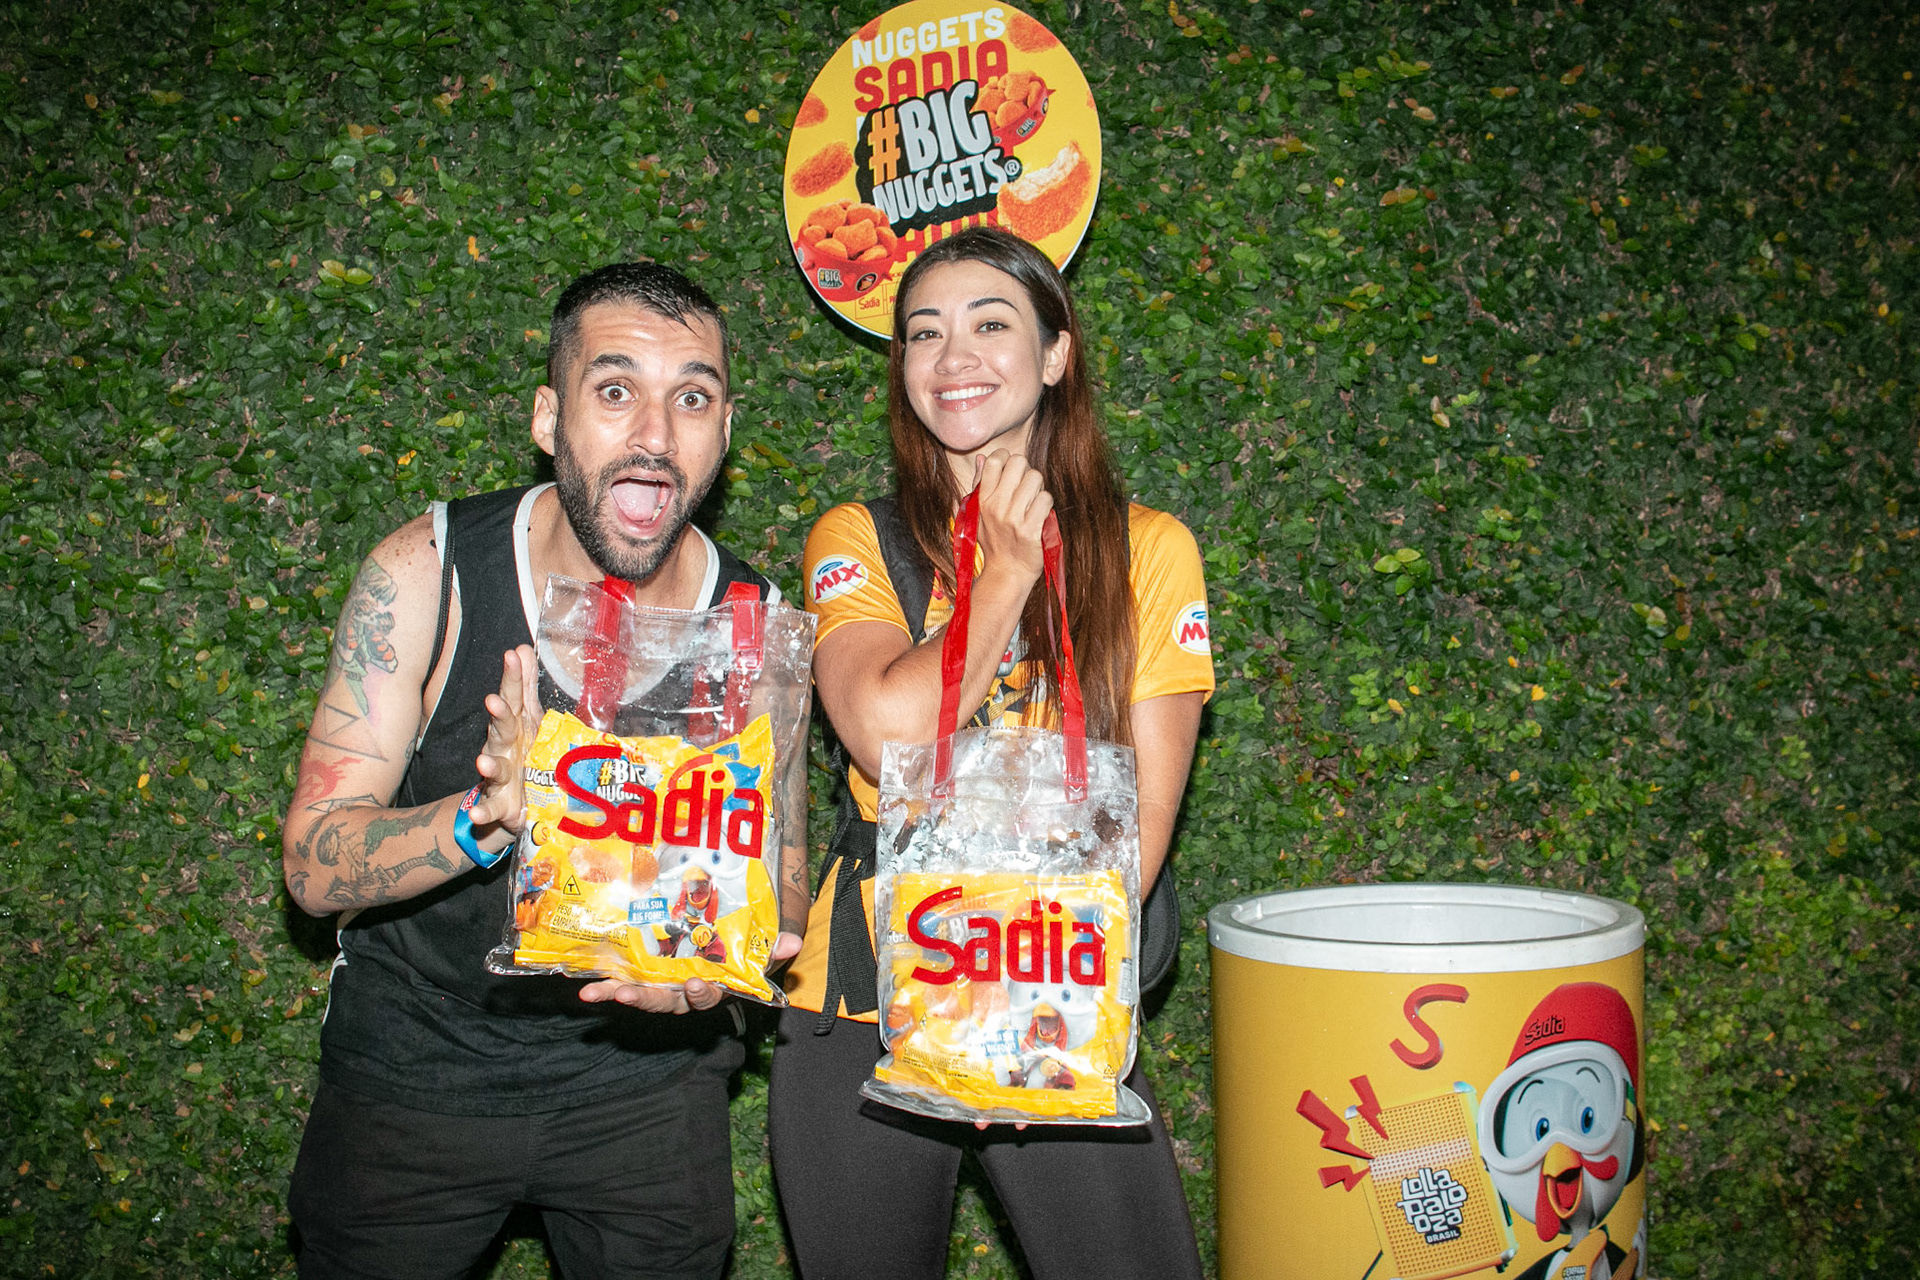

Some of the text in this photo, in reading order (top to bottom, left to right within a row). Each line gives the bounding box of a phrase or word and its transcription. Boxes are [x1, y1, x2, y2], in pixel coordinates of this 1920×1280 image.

[852, 8, 1006, 69] NUGGETS
[854, 39, 1009, 113] SADIA
[868, 80, 992, 186] #BIG
[858, 297, 880, 310] Sadia
[814, 562, 863, 601] MIX
[555, 744, 765, 859] Sadia
[632, 899, 664, 911] PARA SUA
[907, 885, 1107, 987] Sadia
[1388, 983, 1470, 1070] S
[1524, 1014, 1566, 1047] Sadia
[1426, 1230, 1460, 1243] BRASIL
